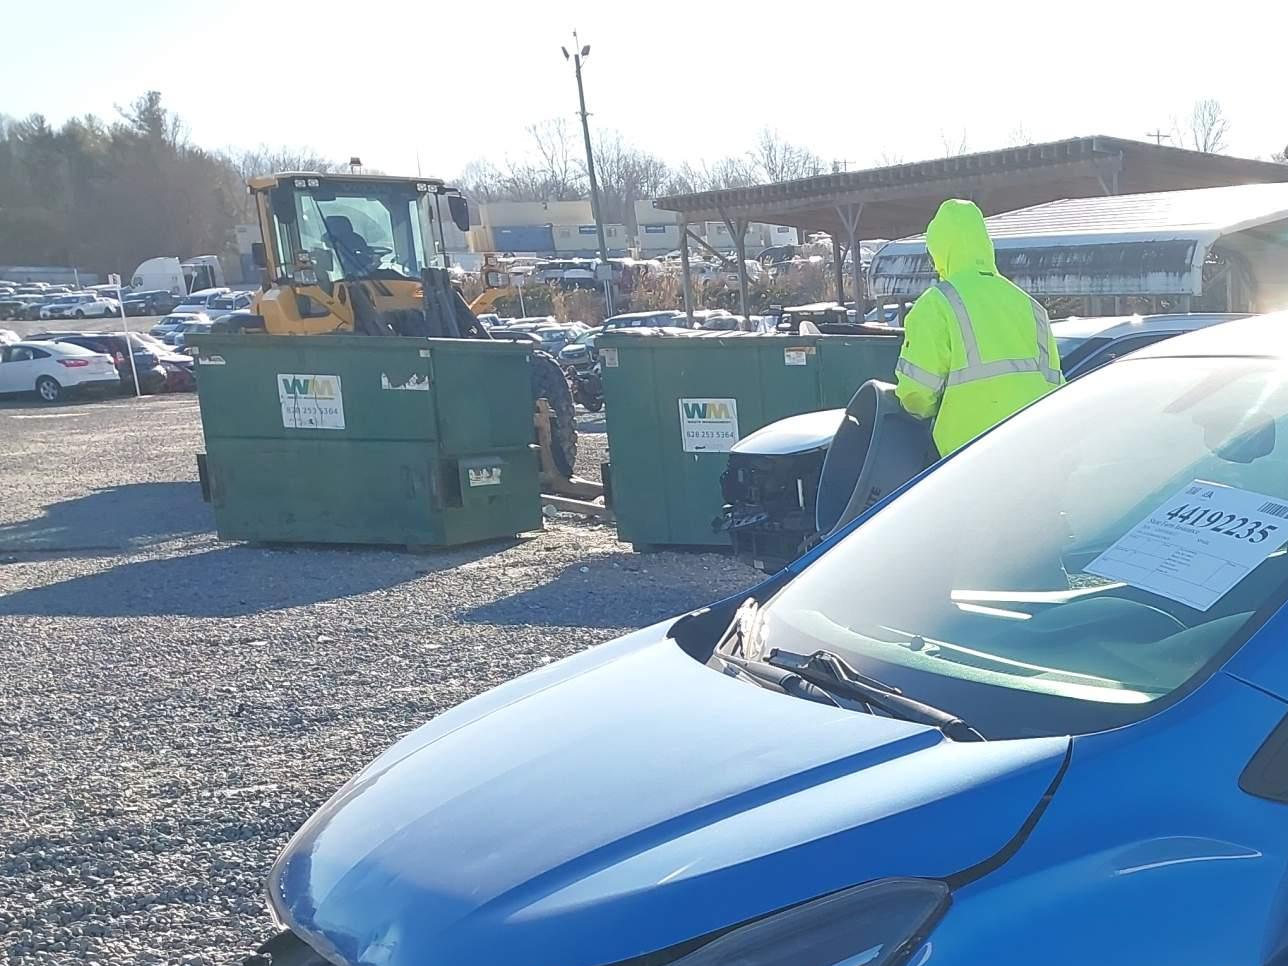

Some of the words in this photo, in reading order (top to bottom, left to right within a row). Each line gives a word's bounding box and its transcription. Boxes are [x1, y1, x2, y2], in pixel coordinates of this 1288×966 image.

[282, 378, 334, 395] WM
[684, 402, 730, 419] WM
[1167, 503, 1279, 544] 44192235
